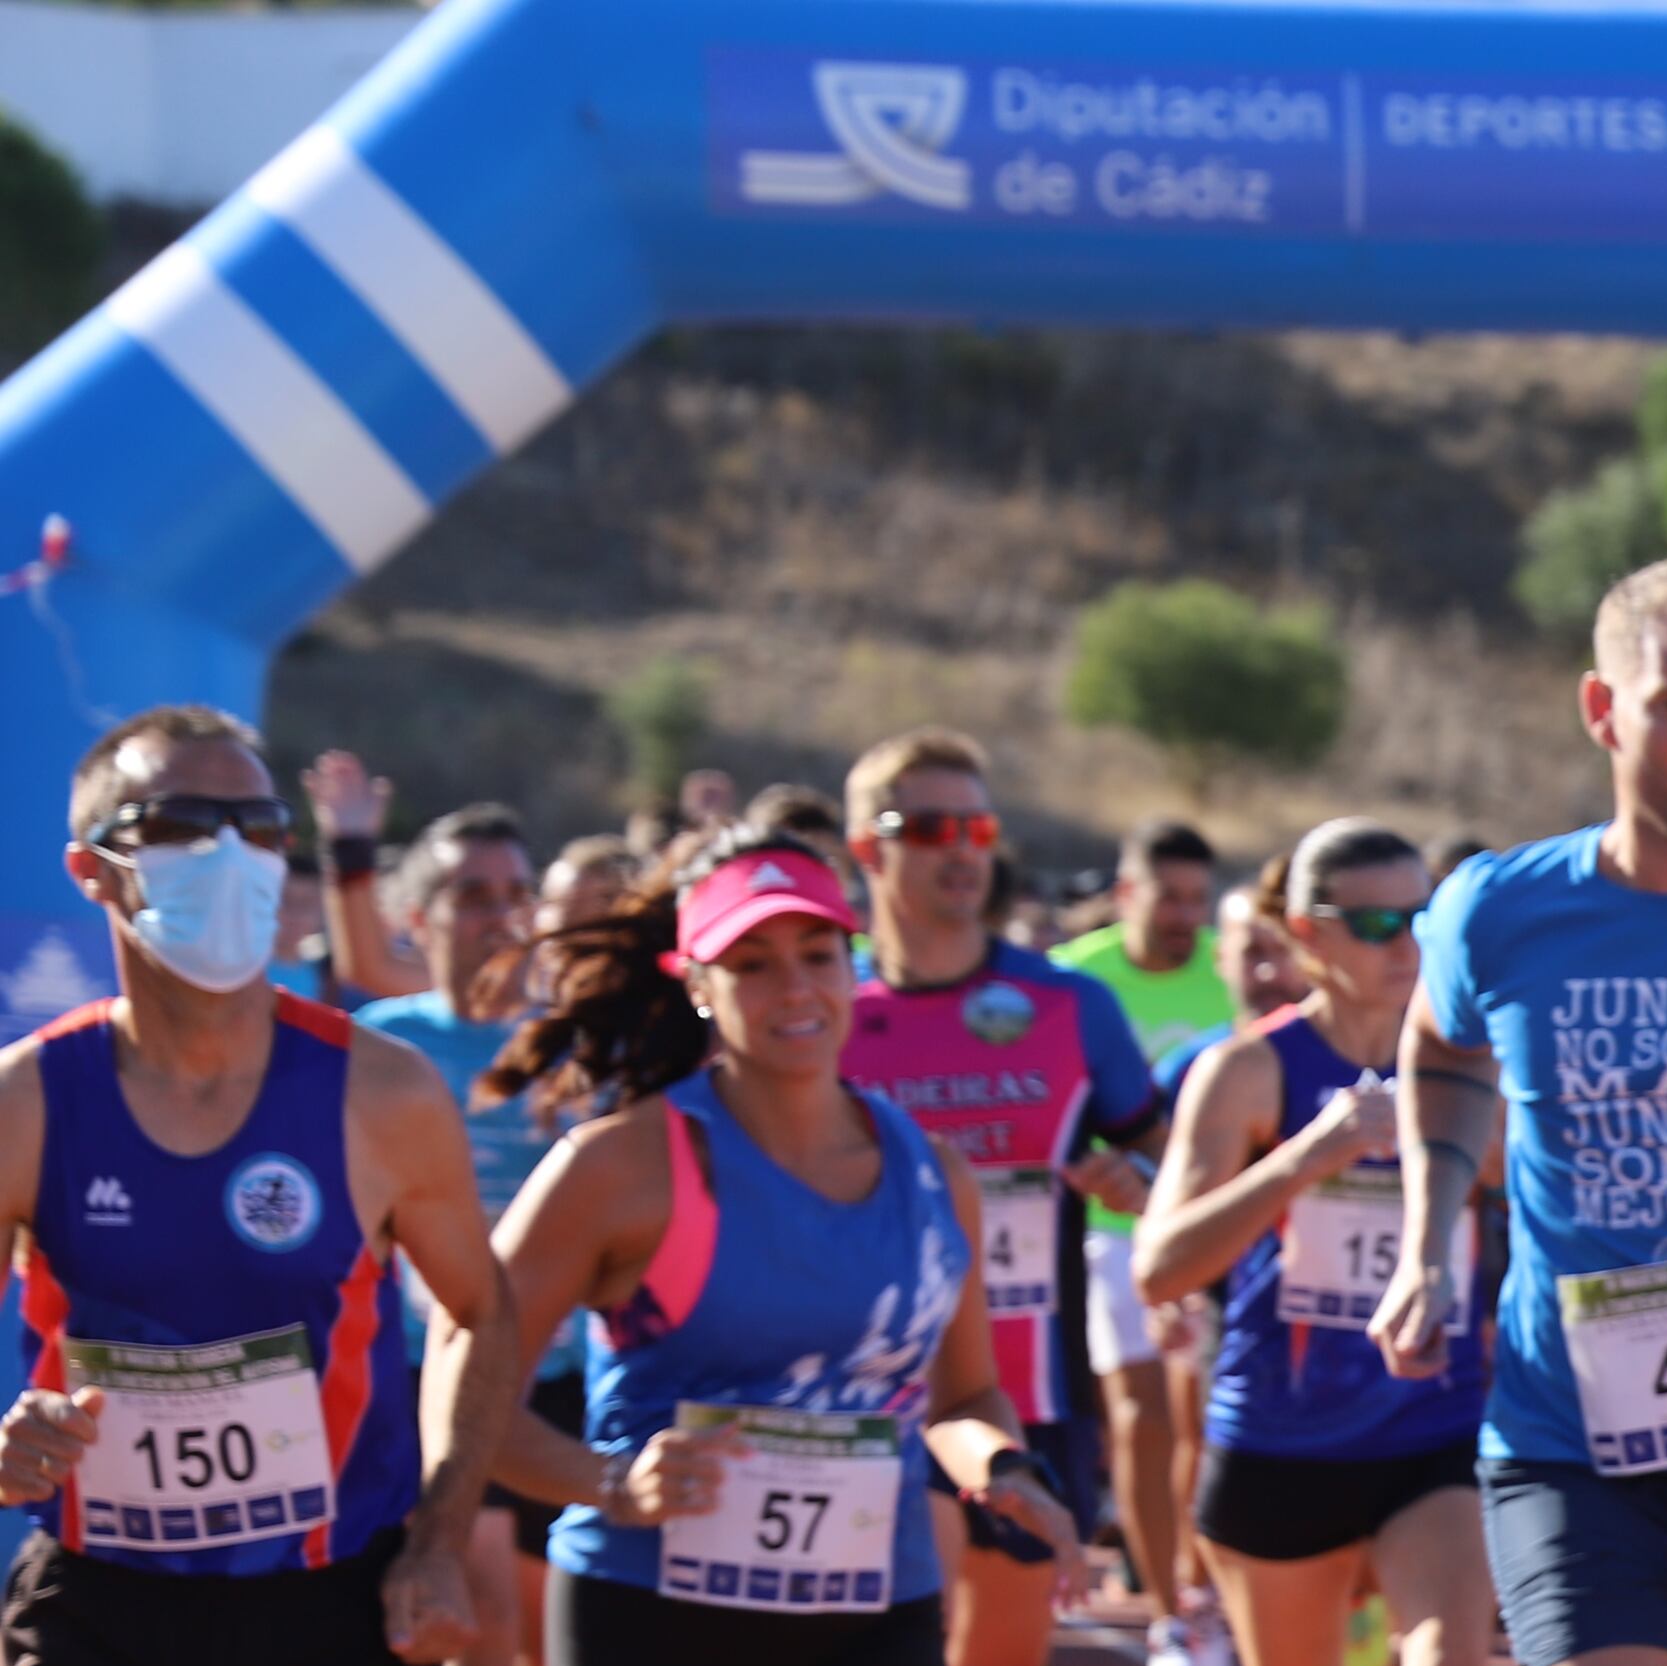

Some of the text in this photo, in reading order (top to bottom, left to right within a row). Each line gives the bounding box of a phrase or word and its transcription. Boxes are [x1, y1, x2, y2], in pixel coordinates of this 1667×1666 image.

[992, 67, 1329, 144] Diputación
[995, 150, 1270, 223] de Cádiz
[1554, 1027, 1617, 1071] NO
[134, 1422, 257, 1490] 150
[757, 1490, 832, 1553] 57
